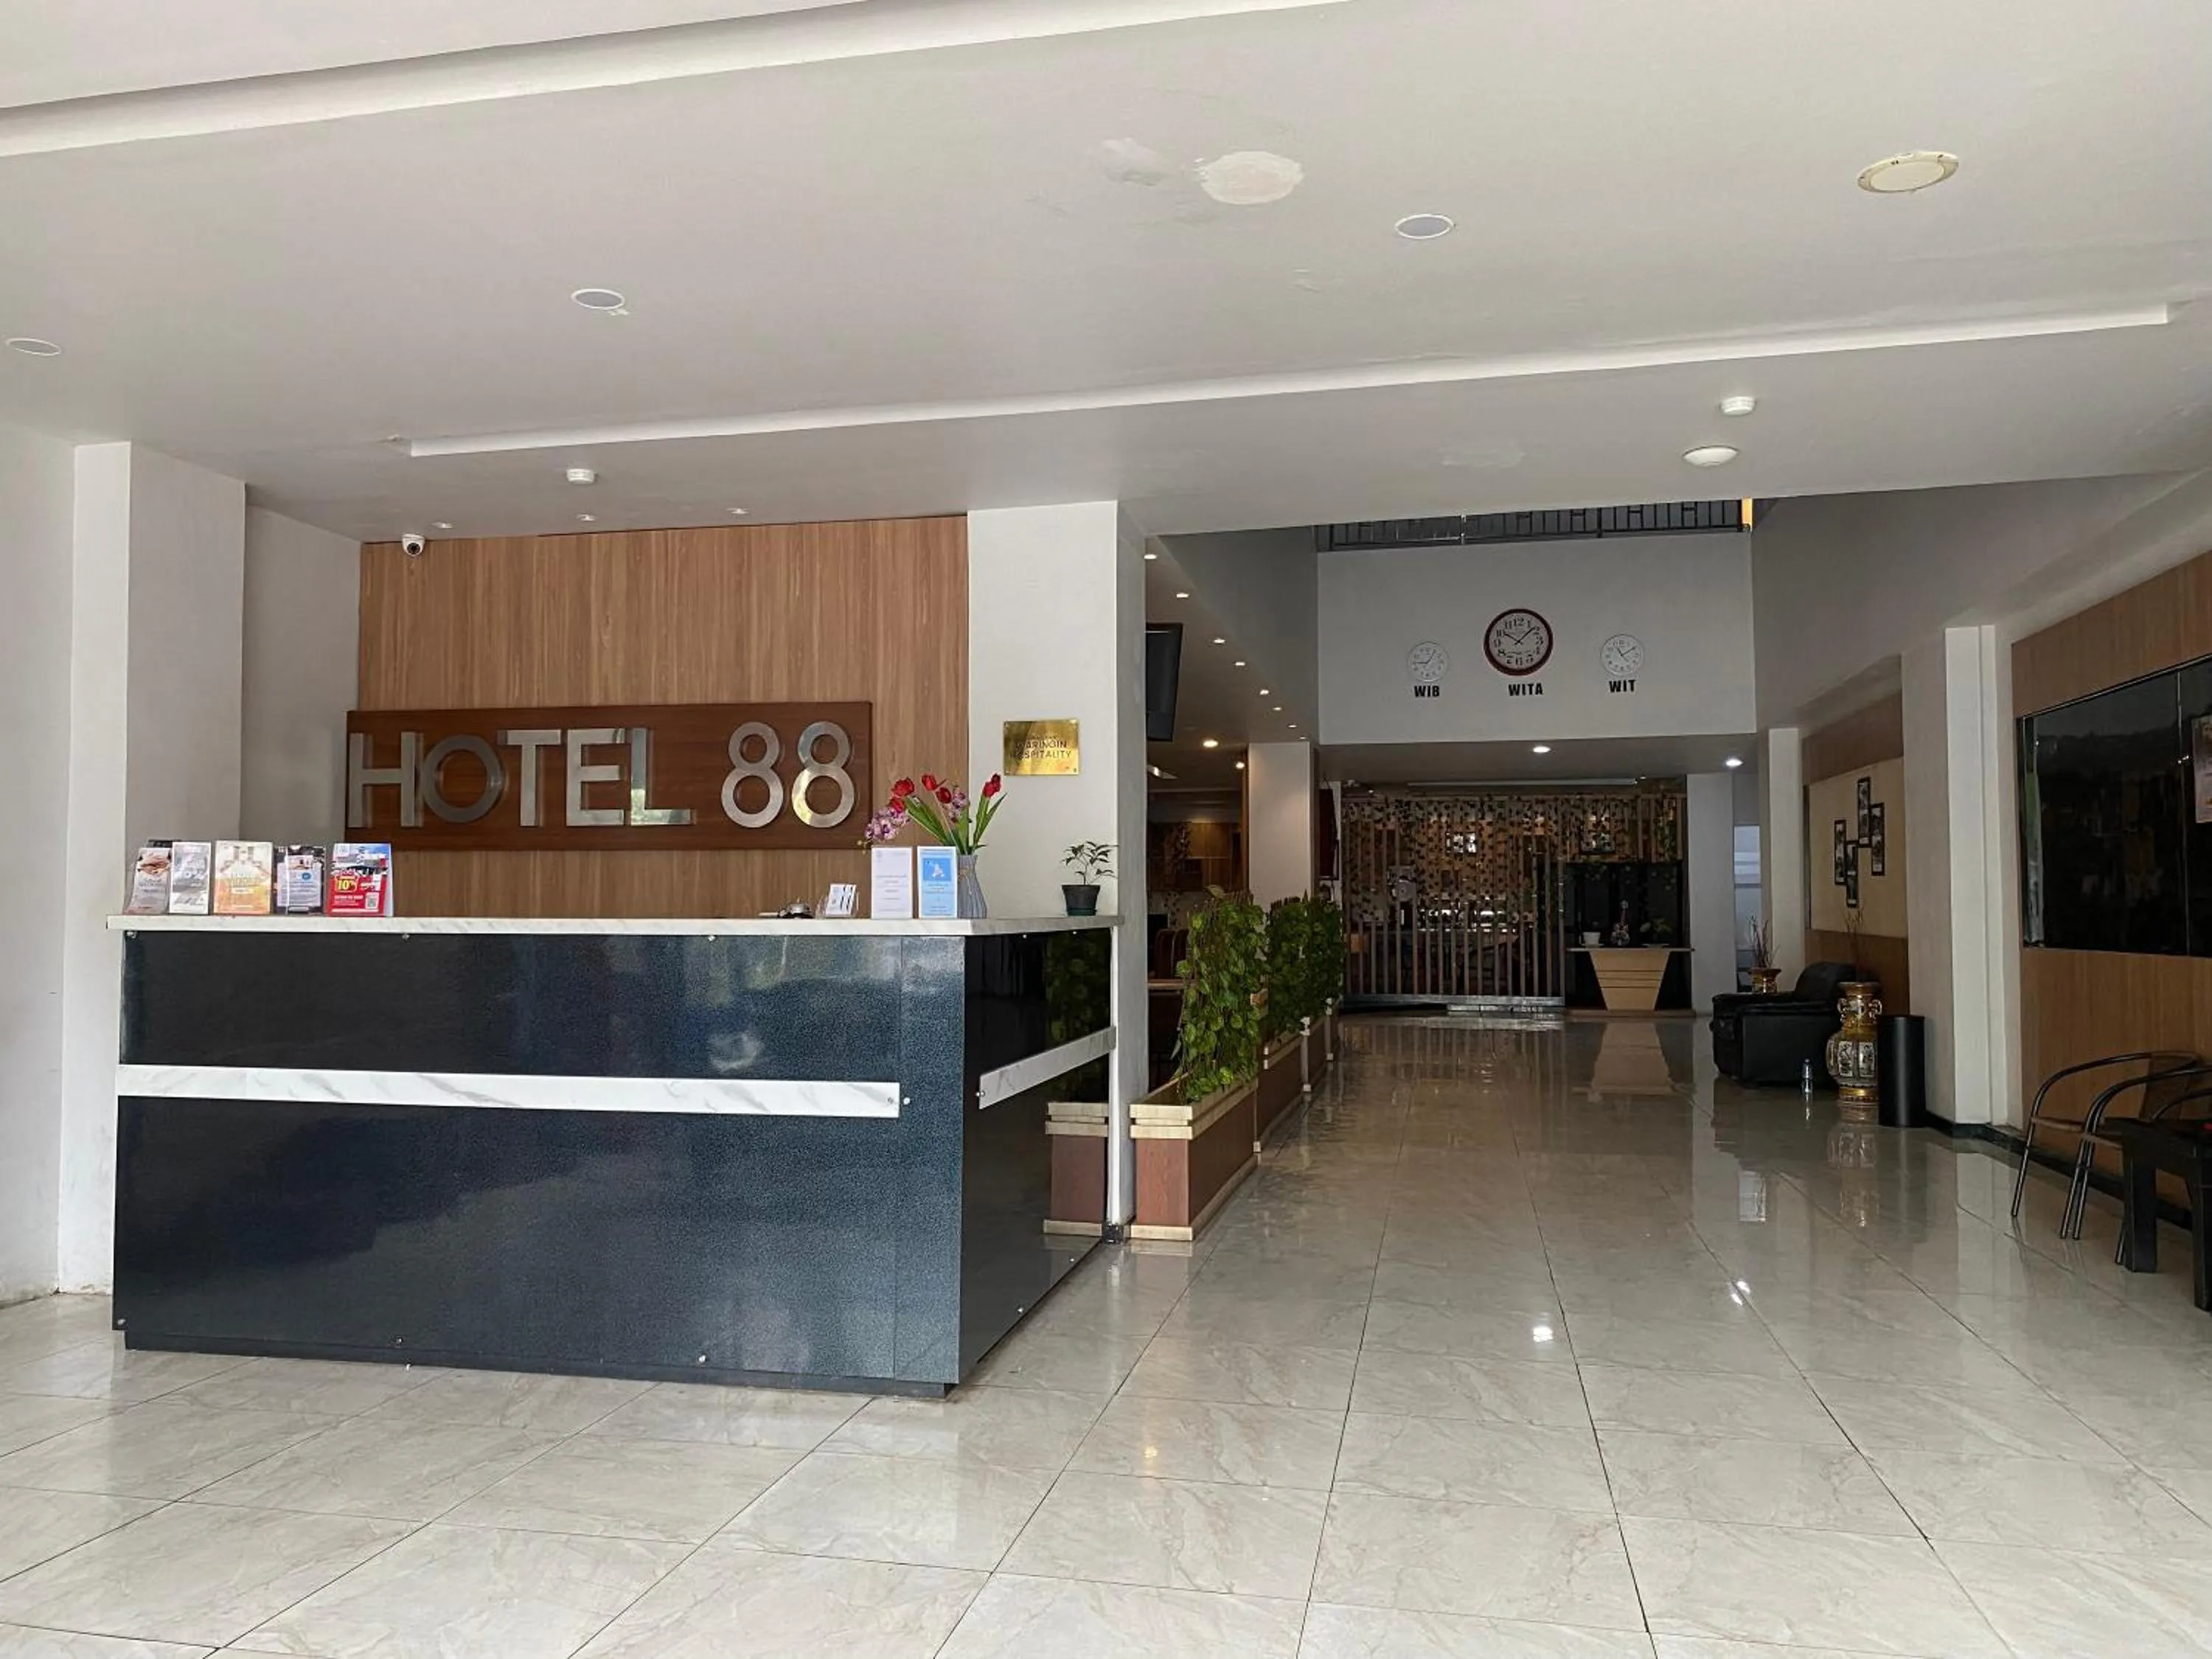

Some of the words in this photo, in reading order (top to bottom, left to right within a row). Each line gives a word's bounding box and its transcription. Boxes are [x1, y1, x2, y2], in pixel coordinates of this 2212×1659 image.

[1514, 618, 1524, 626] 12
[1413, 685, 1440, 698] WIB
[1509, 683, 1543, 696] WITA
[1609, 679, 1636, 692] WIT
[1011, 750, 1071, 758] SPITALITY
[347, 728, 692, 828] HOTEL
[720, 720, 856, 828] 88
